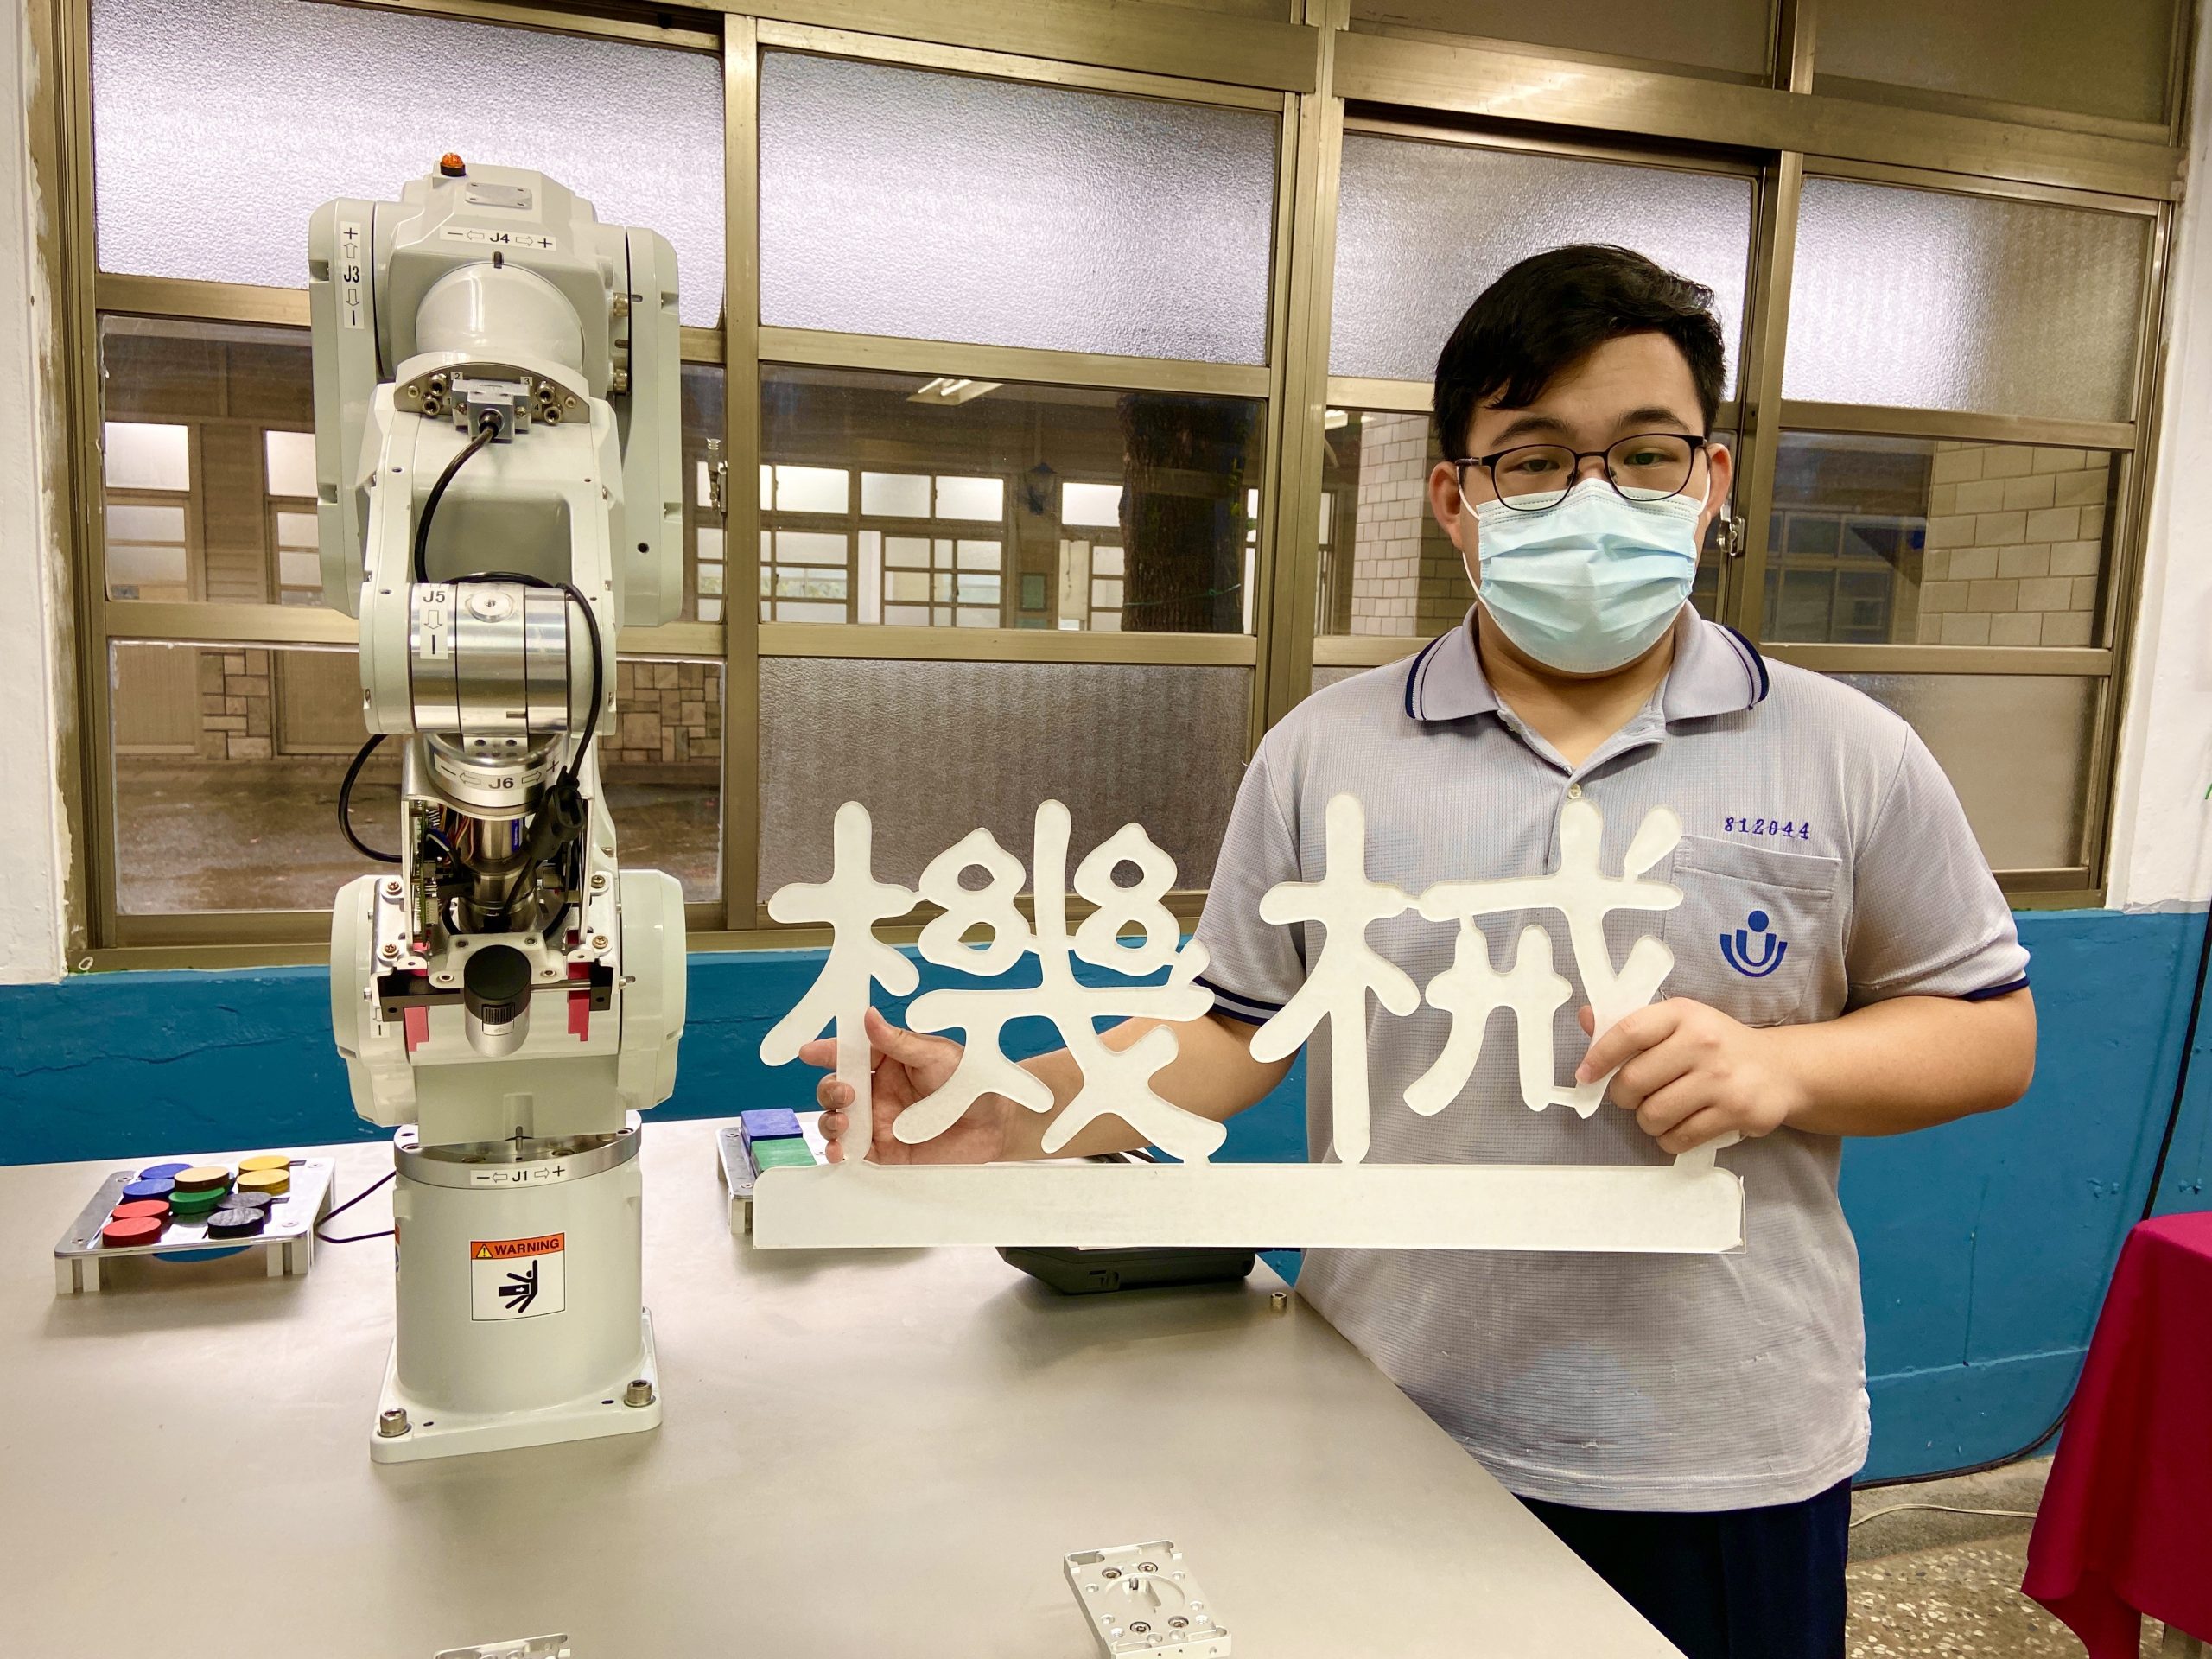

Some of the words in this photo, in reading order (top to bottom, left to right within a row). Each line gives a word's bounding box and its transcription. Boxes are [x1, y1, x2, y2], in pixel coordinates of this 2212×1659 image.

[490, 232, 510, 244] J4
[343, 264, 360, 283] J3
[423, 591, 445, 603] J5
[488, 778, 514, 789] J6
[1723, 816, 1811, 840] 812044
[759, 792, 1739, 1164] 機械
[512, 1171, 528, 1181] J1
[493, 1237, 561, 1259] WARNING
